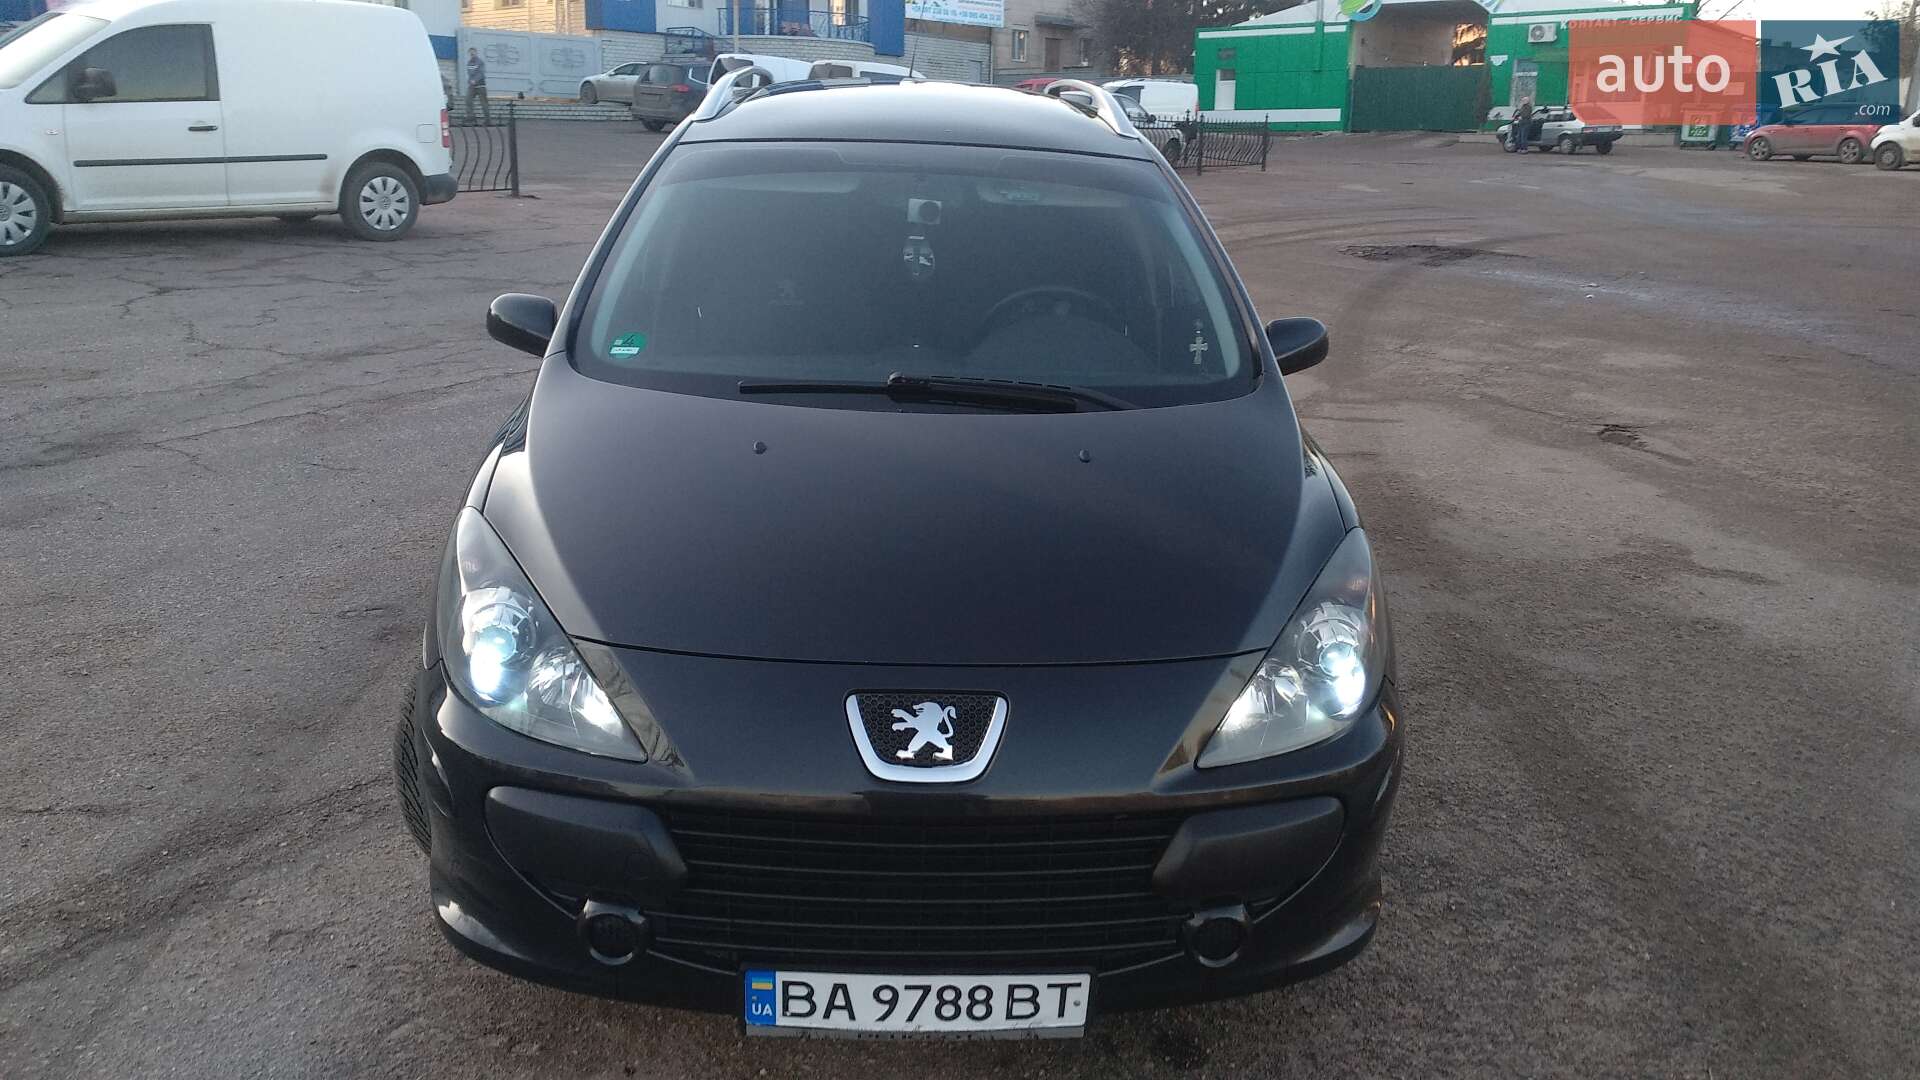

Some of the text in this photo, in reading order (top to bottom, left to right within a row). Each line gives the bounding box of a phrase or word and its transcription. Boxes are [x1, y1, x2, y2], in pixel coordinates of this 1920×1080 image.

[751, 1003, 773, 1016] UA
[781, 980, 1082, 1022] BA 9788 BT
